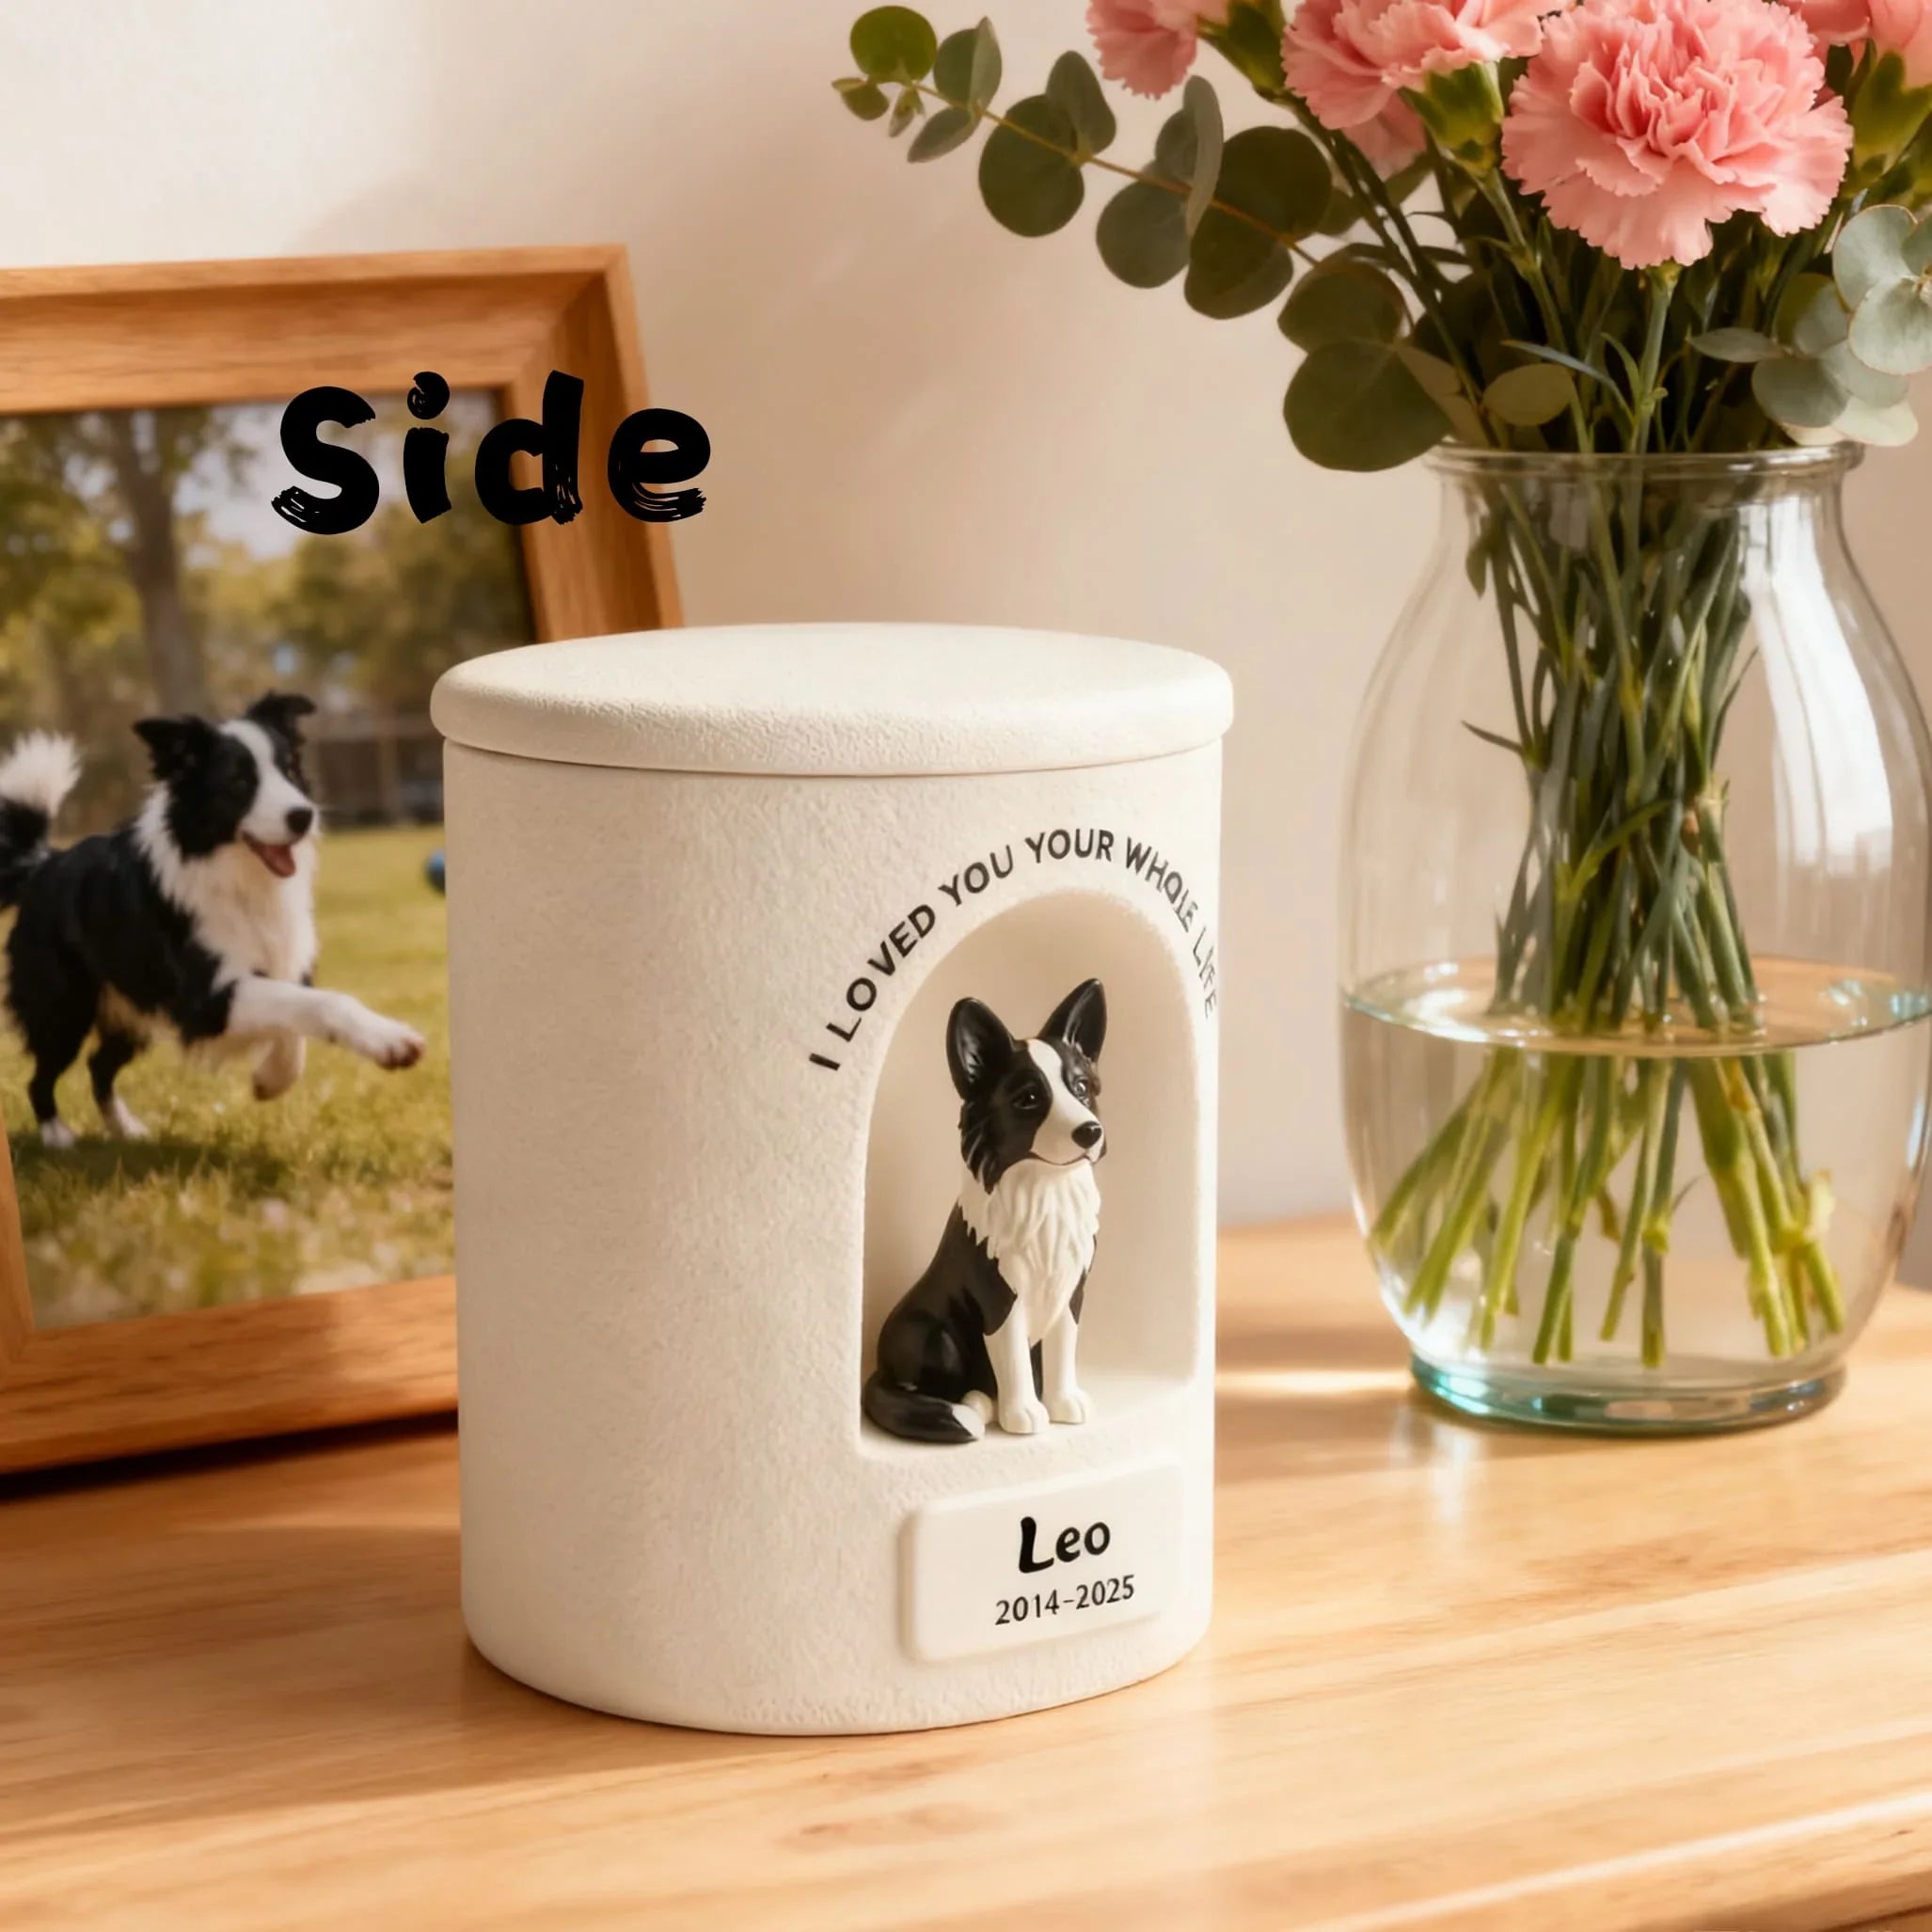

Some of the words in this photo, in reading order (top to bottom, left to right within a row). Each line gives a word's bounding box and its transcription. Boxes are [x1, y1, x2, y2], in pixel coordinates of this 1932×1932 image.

[808, 1052, 841, 1071] I
[826, 903, 936, 1042] LOVED
[938, 844, 1015, 907] YOU
[1024, 828, 1115, 863] YOUR
[1125, 836, 1198, 933] WHOLE
[1018, 1516, 1111, 1574] Leo
[994, 1574, 1135, 1626] 2014-2025
